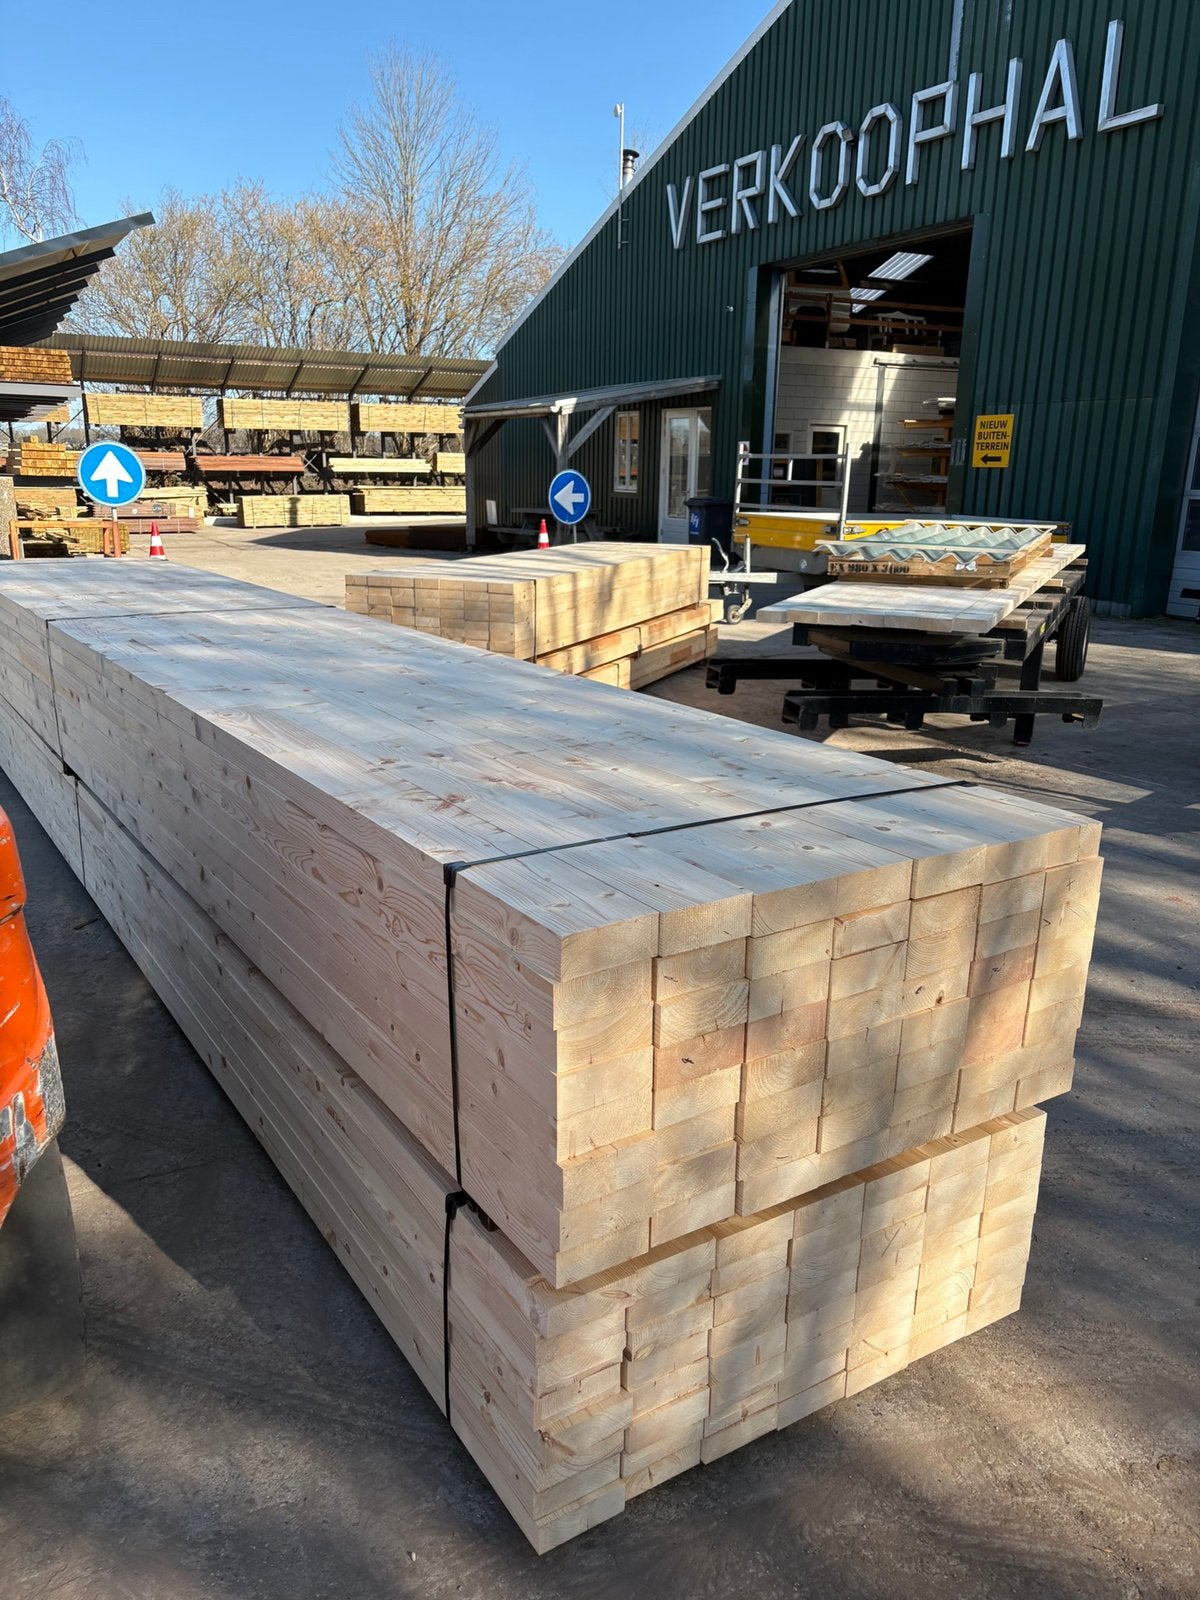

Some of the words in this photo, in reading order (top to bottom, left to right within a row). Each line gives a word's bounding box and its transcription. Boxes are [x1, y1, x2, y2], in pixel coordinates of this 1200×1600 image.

[665, 19, 1165, 251] VERKOOPHAL
[980, 420, 1008, 429] NIEUW
[977, 431, 1010, 440] BUITEN-
[976, 442, 1009, 451] TERREIN
[848, 563, 868, 573] 980
